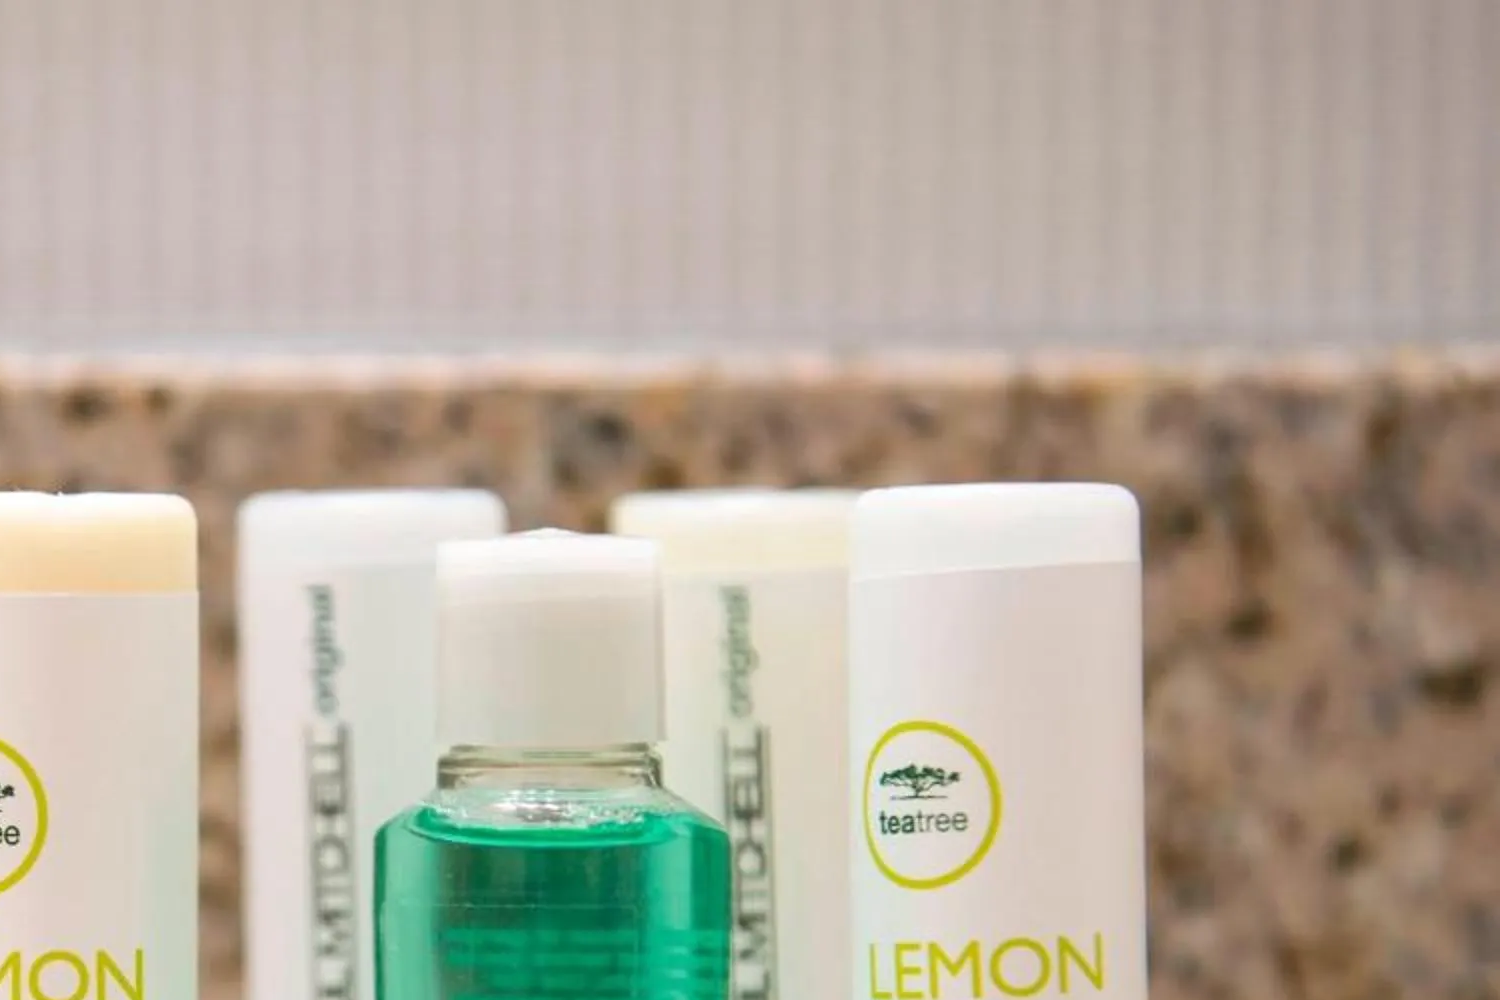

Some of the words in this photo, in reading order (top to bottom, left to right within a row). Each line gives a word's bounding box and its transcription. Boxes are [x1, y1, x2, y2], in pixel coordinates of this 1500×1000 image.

[311, 727, 348, 955] MITCHELL
[728, 730, 766, 964] MITCHELL
[879, 809, 968, 835] teatree
[868, 933, 1104, 1000] LEMON
